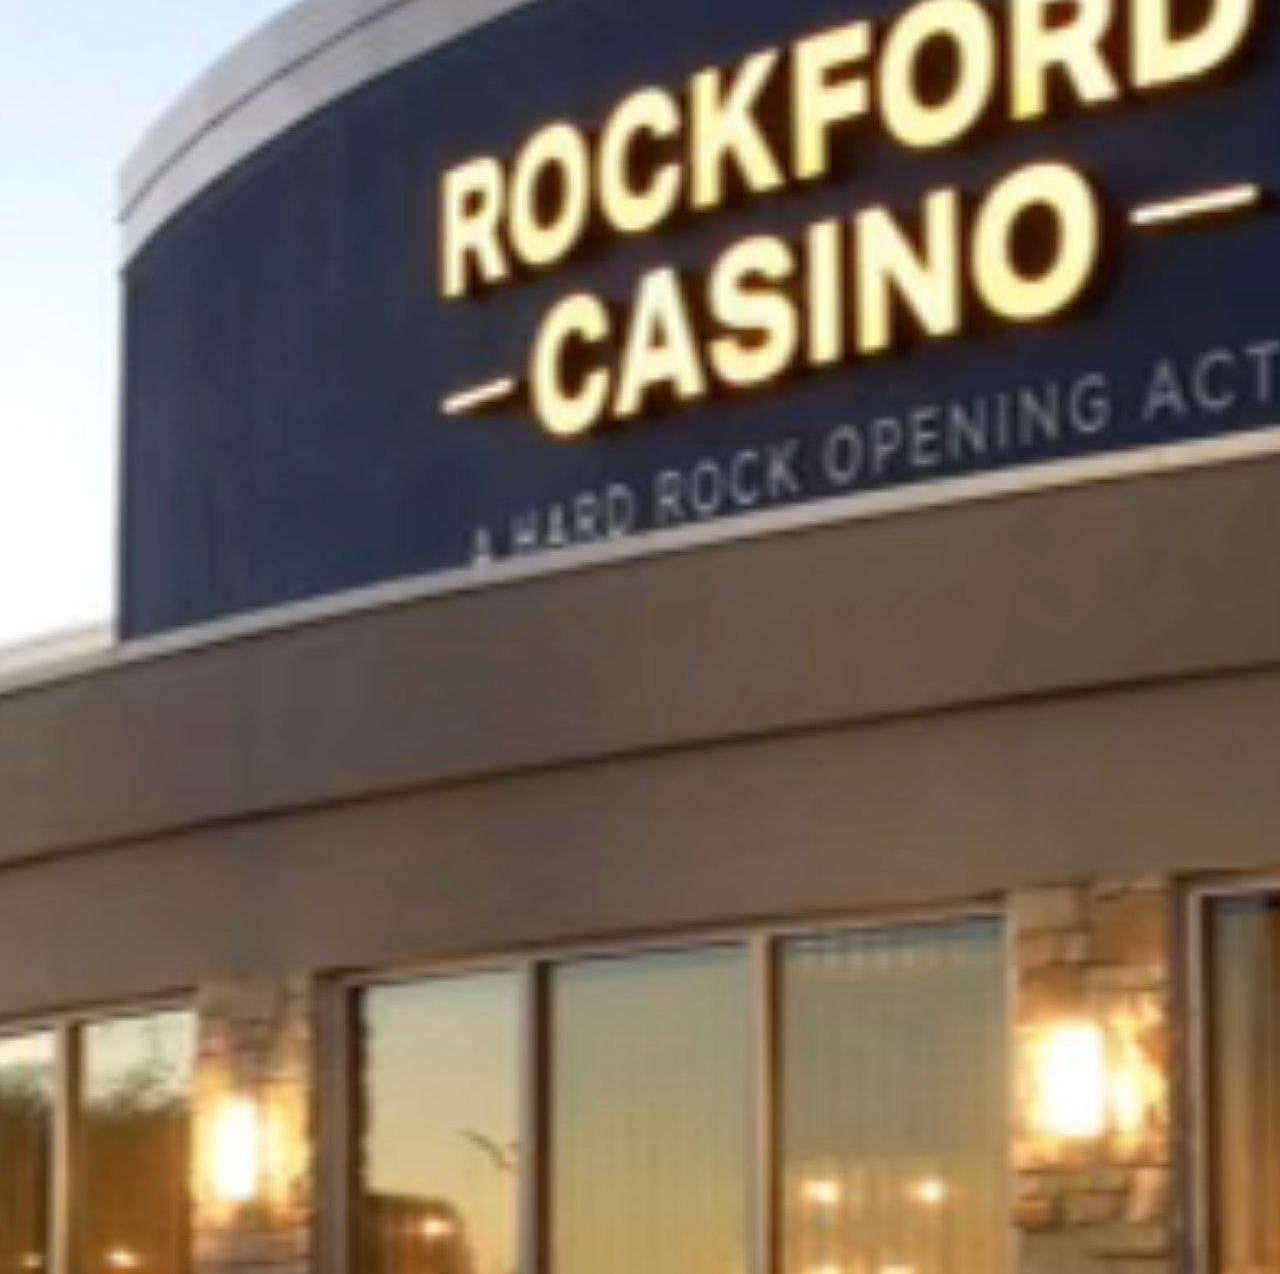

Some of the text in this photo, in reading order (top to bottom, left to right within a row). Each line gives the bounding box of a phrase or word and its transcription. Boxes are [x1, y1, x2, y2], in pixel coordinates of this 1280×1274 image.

[531, 161, 1100, 436] CASINO
[510, 483, 635, 547] HARD
[656, 438, 801, 523] ROCK
[822, 371, 1111, 484] OPENING
